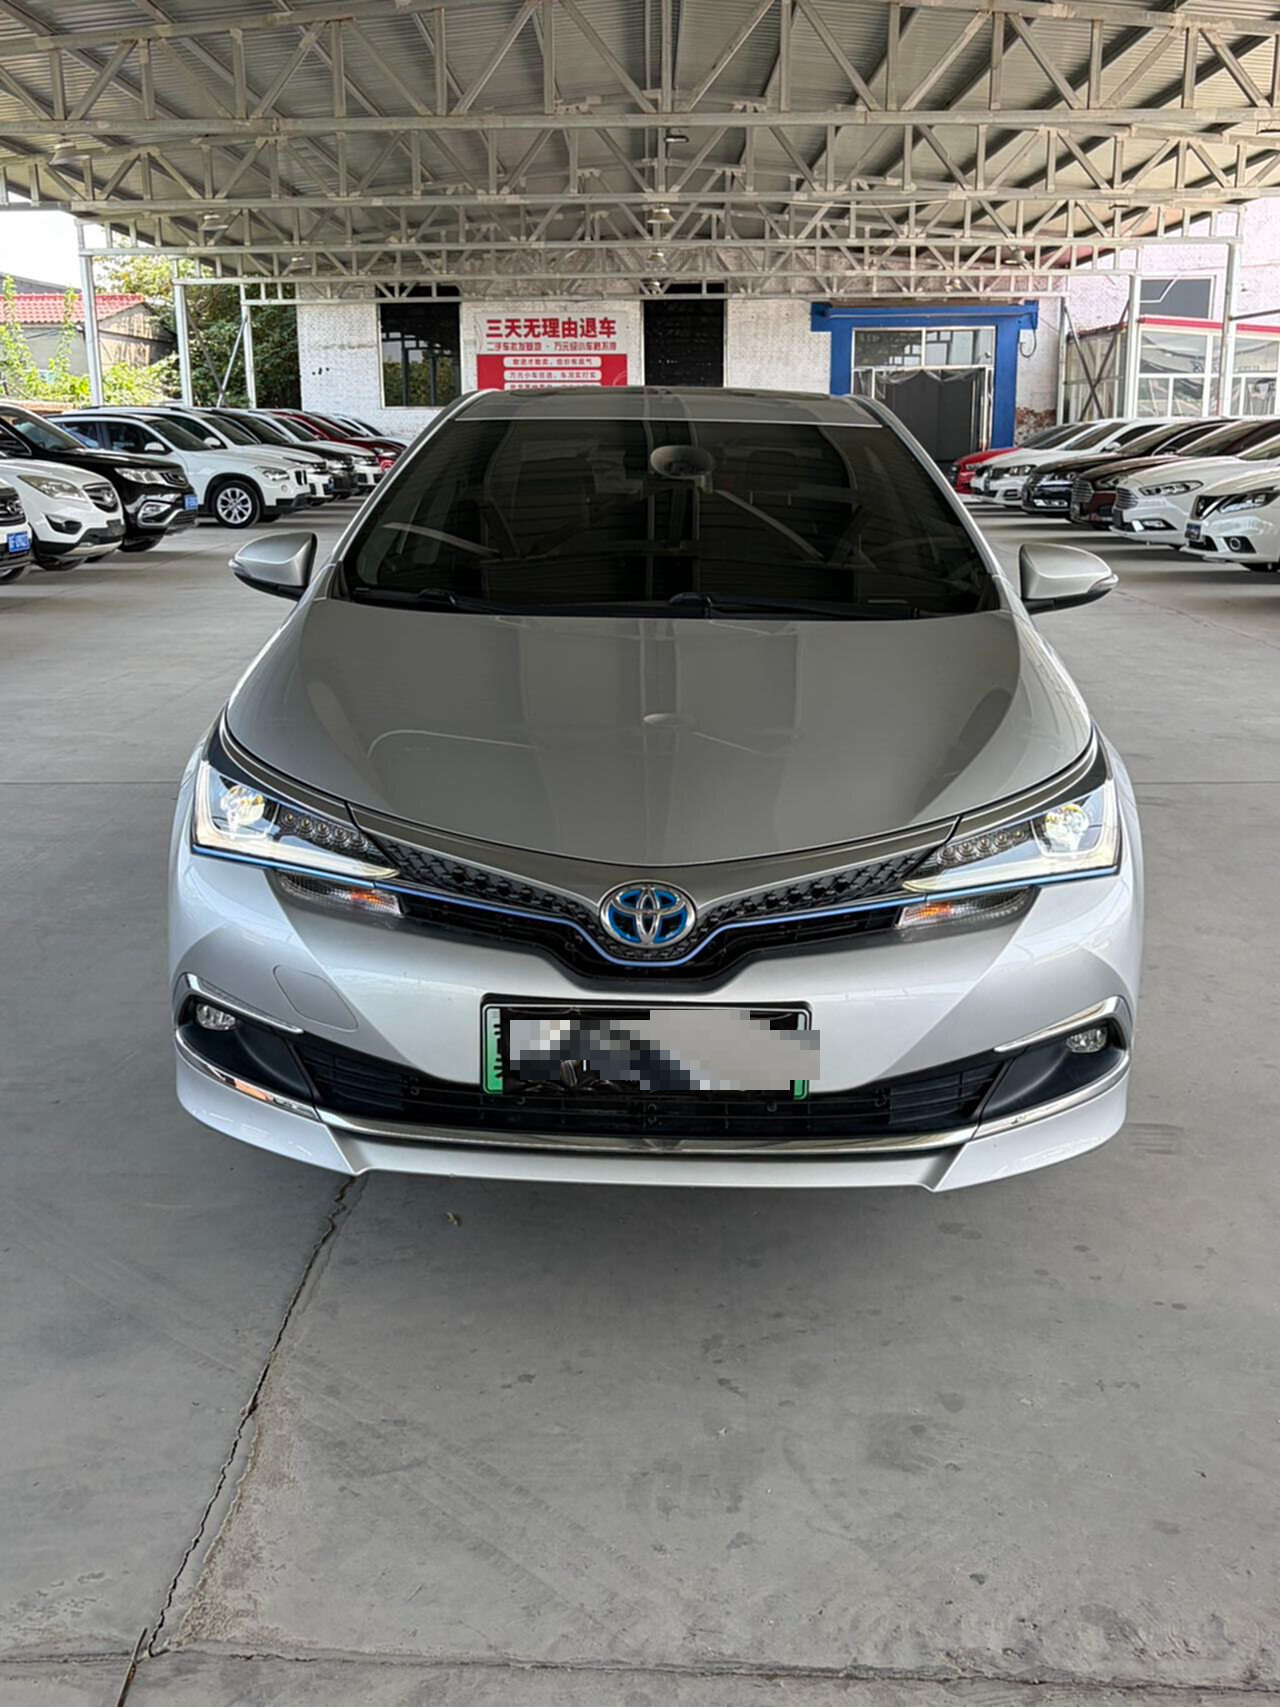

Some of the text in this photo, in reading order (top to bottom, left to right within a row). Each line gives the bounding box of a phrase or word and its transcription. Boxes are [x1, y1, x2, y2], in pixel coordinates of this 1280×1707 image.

[486, 317, 617, 339] 三天无理由退车
